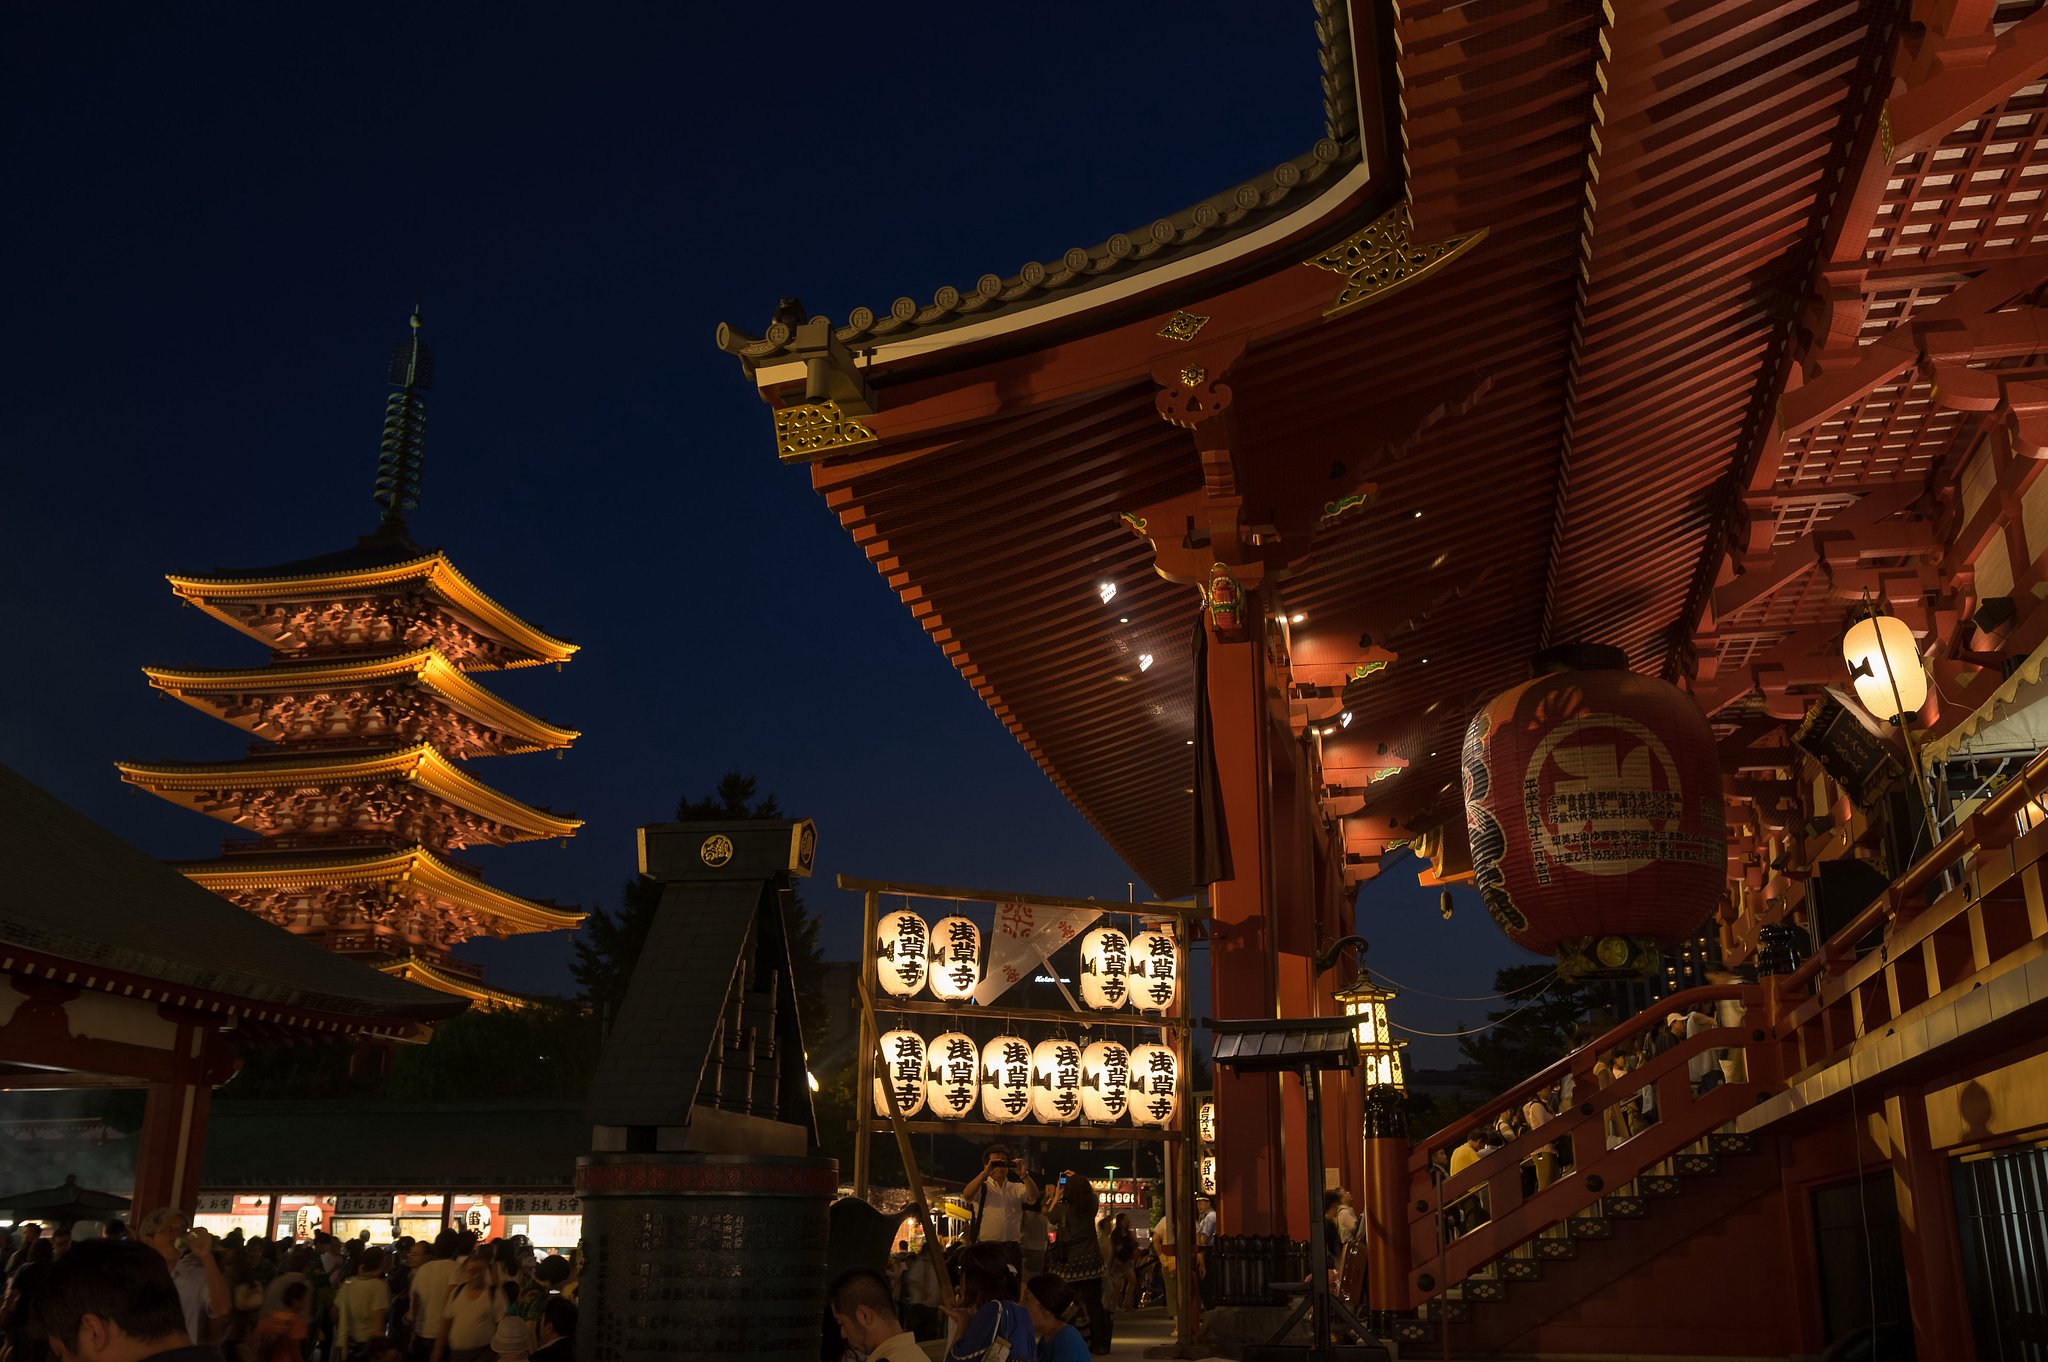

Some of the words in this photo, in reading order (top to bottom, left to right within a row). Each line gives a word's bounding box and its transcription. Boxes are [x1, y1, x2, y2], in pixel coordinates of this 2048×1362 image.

[897, 916, 925, 987] 浅草寺
[949, 921, 975, 990] 浅草寺
[1101, 933, 1127, 1002] 浅草寺
[1149, 936, 1174, 1004] 浅草寺
[895, 1036, 923, 1111] 浅草寺
[945, 1039, 974, 1111] 浅草寺
[1001, 1042, 1028, 1115] 浅草寺
[1054, 1046, 1080, 1116] 浅草寺
[1103, 1046, 1128, 1115] 浅草寺
[1147, 1050, 1175, 1119] 浅草寺
[367, 1198, 388, 1210] お守
[531, 1199, 553, 1211] お札
[558, 1199, 579, 1211] お守
